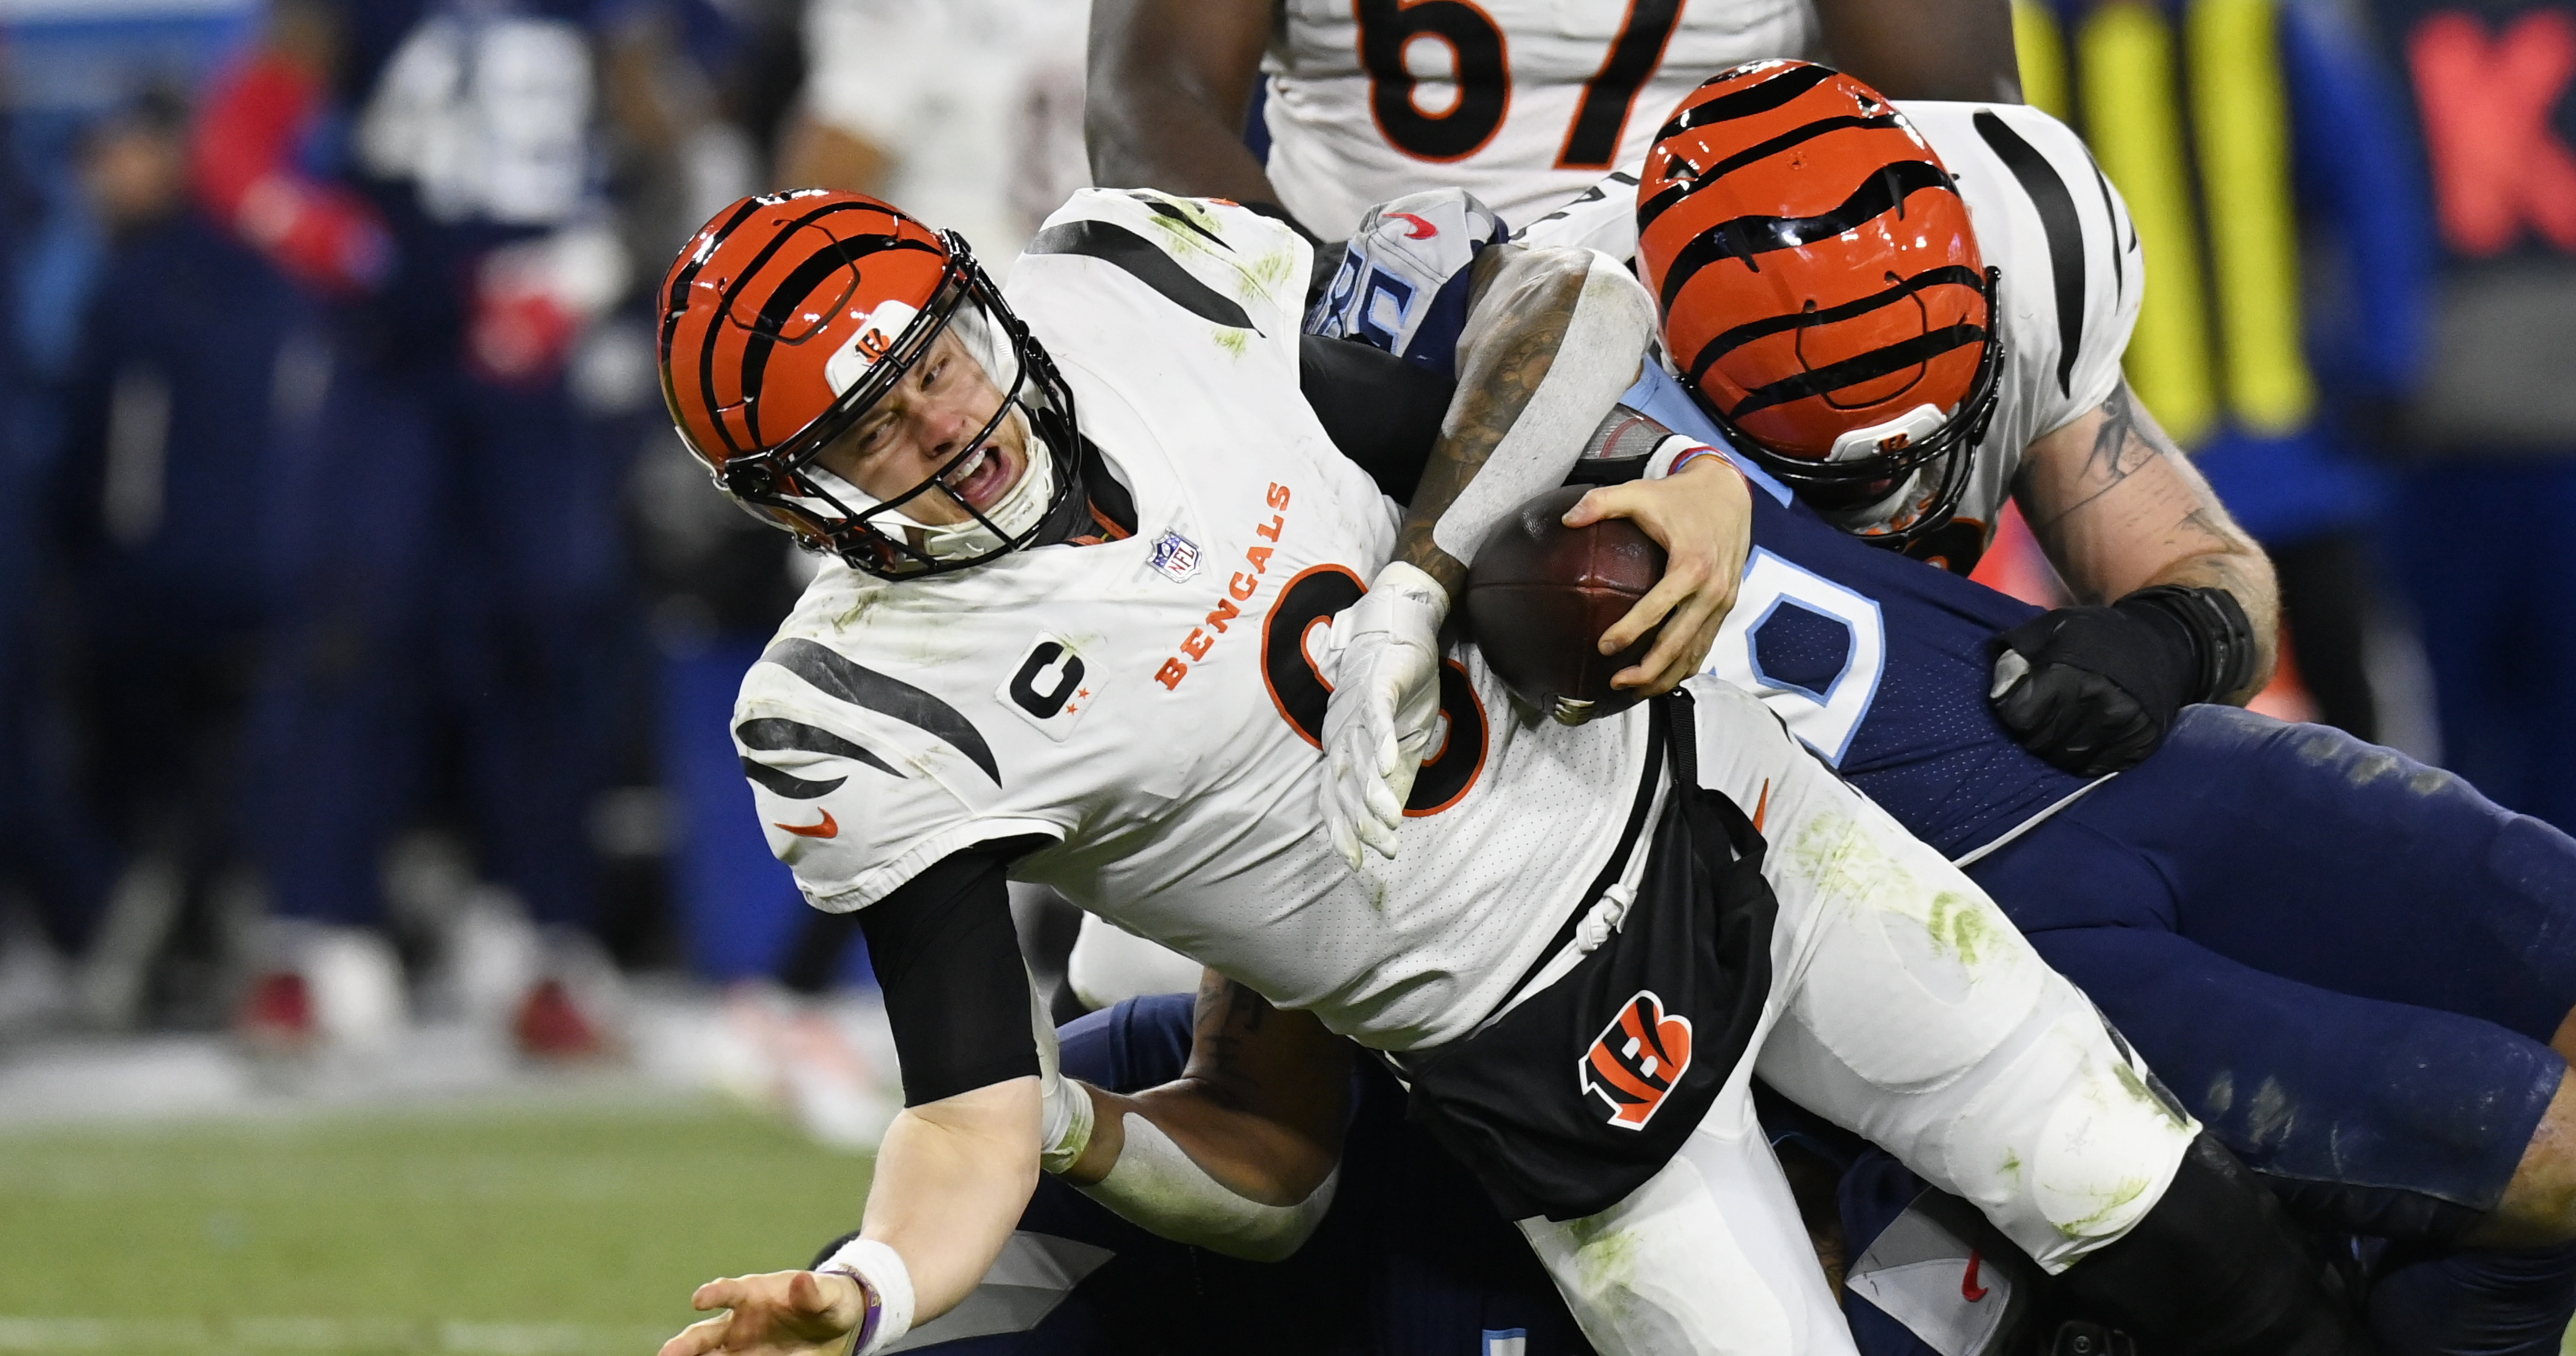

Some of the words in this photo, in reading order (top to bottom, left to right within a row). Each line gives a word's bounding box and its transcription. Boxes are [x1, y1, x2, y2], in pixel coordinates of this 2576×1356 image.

[1154, 482, 1291, 691] BENGALS
[1167, 546, 1195, 575] NFL
[1009, 641, 1085, 719] C
